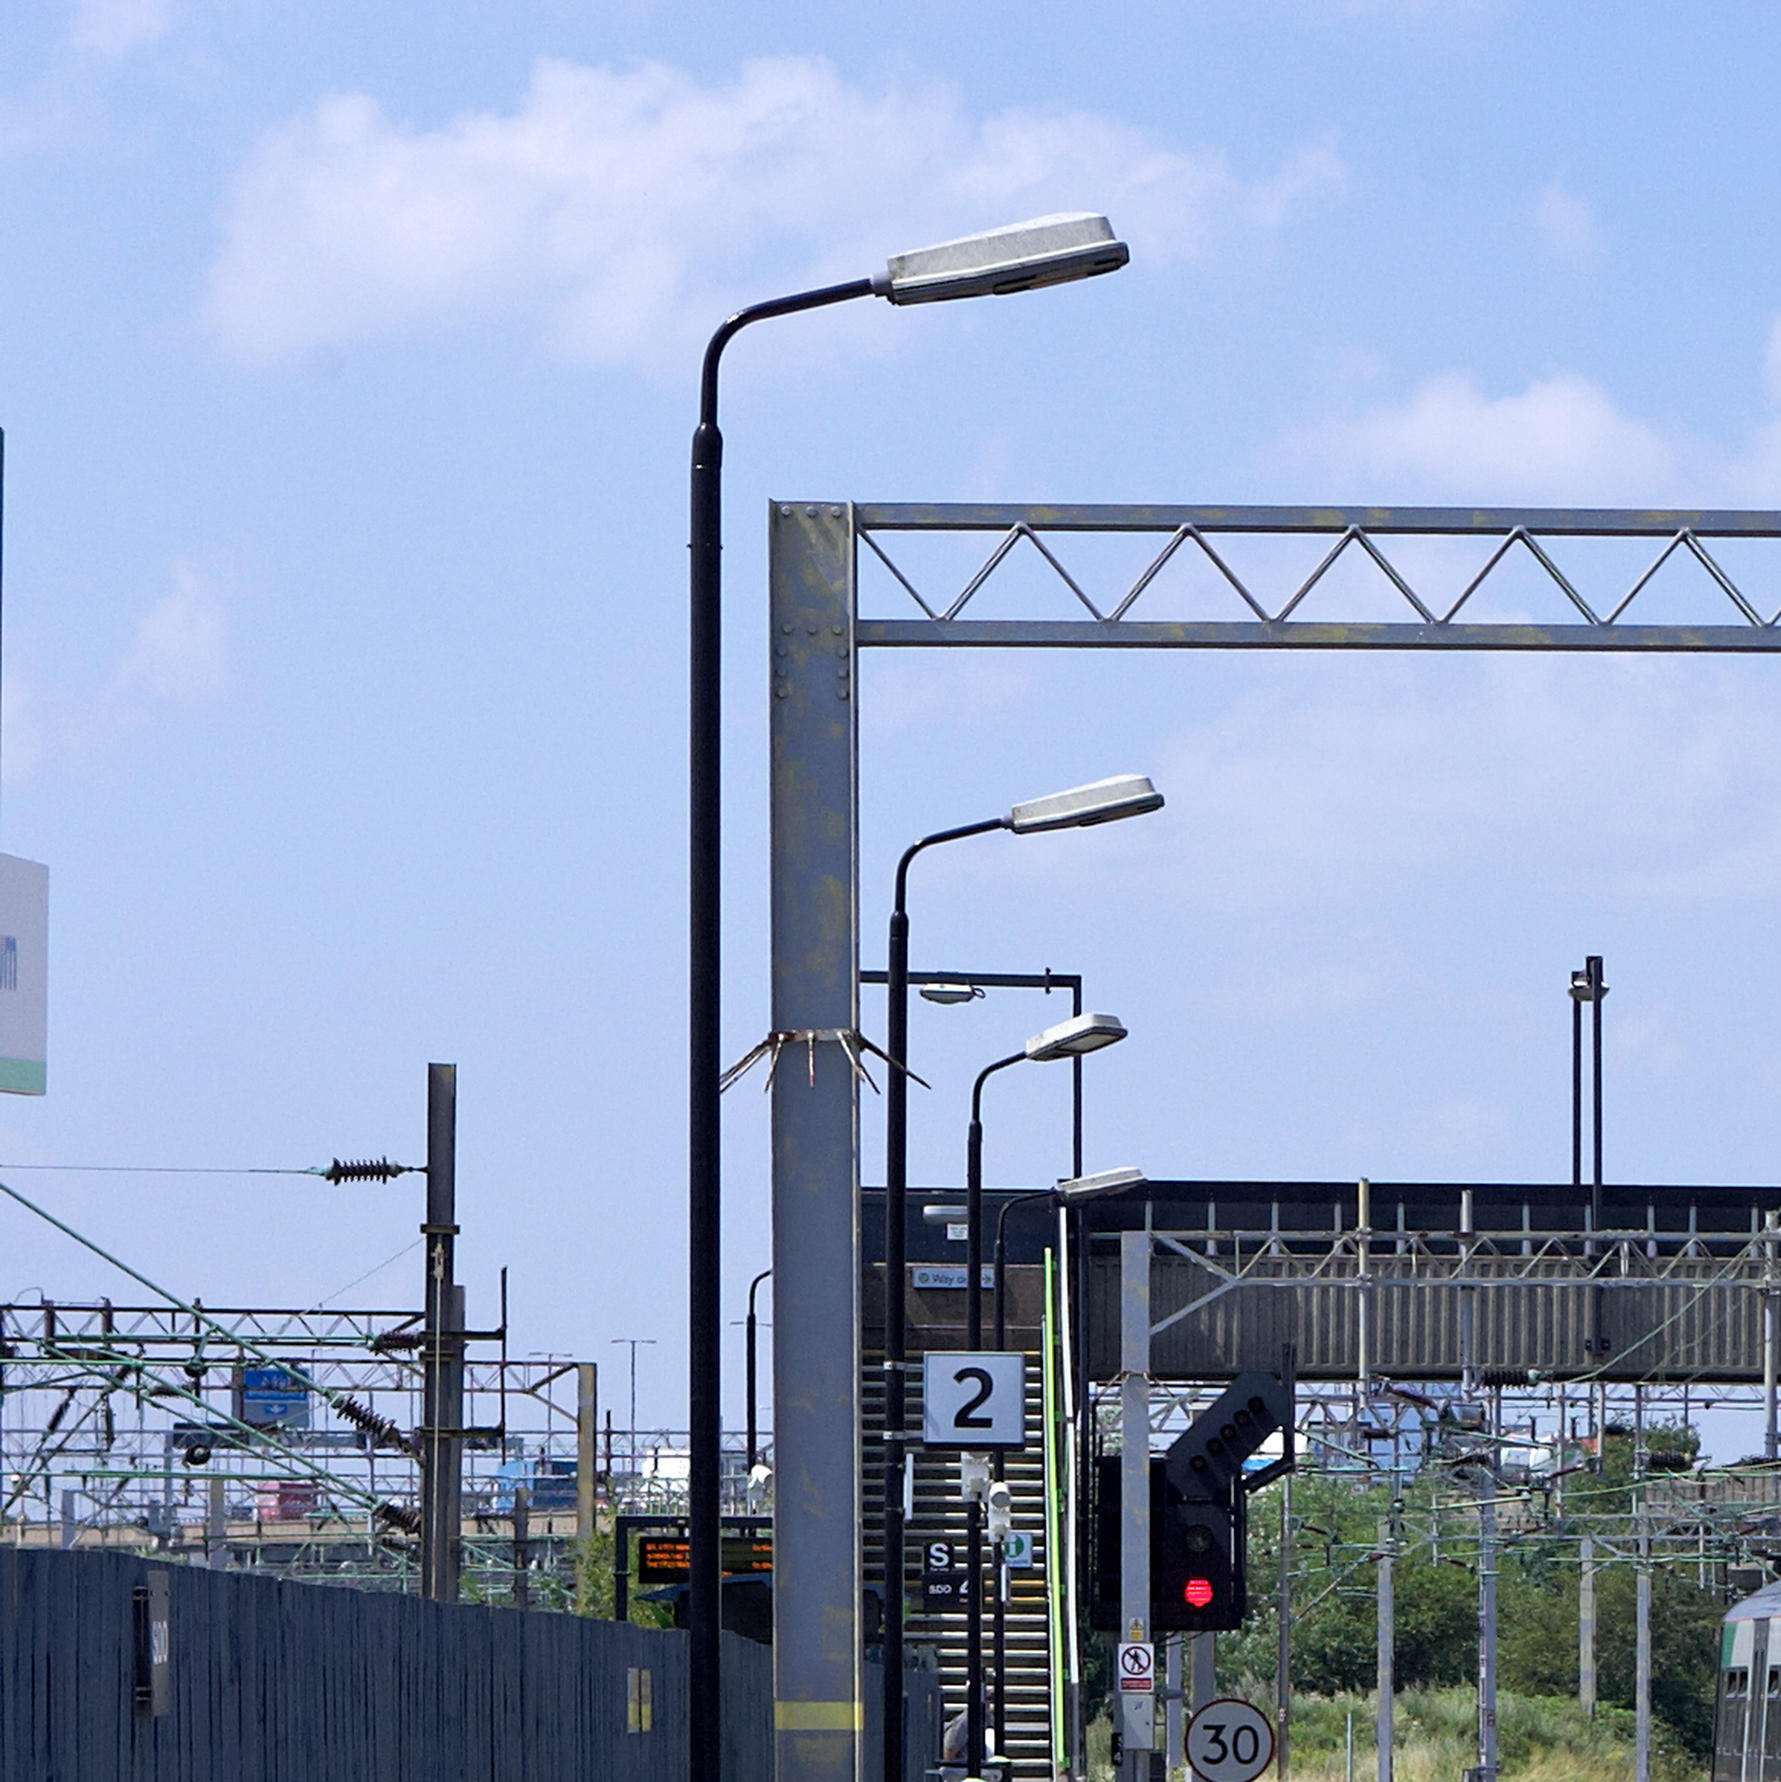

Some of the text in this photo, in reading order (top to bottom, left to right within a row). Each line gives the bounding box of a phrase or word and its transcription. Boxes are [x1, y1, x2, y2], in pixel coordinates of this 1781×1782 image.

[953, 1366, 994, 1429] 2
[929, 1543, 950, 1567] S
[1202, 1723, 1260, 1767] 30
